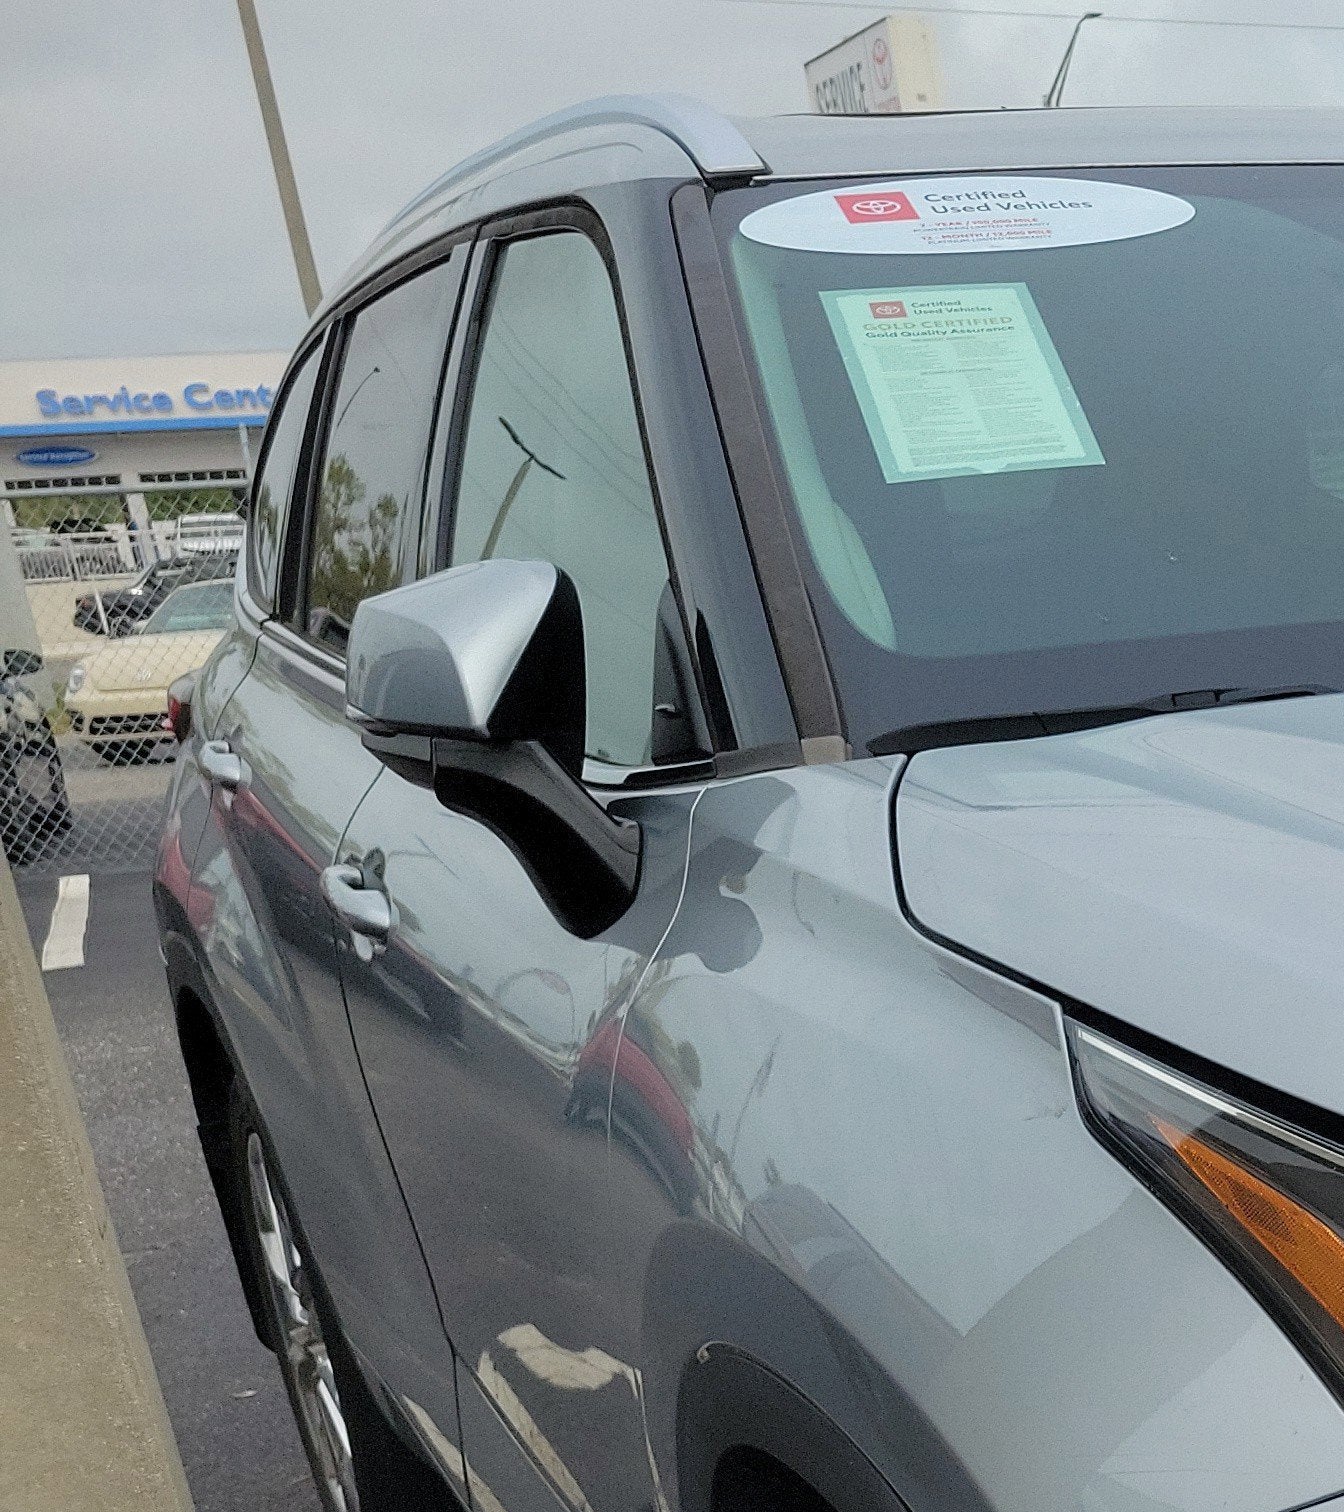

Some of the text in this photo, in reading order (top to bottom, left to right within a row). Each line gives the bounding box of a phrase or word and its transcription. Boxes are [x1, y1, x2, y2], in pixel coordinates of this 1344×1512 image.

[924, 189, 1027, 202] Certified
[931, 200, 1093, 214] Used Vehicles
[911, 300, 961, 308] Certified
[863, 316, 1013, 331] GOLD CERTIFIED
[865, 325, 1015, 338] Gold Quality Assurance
[36, 381, 274, 417] Service Cent
